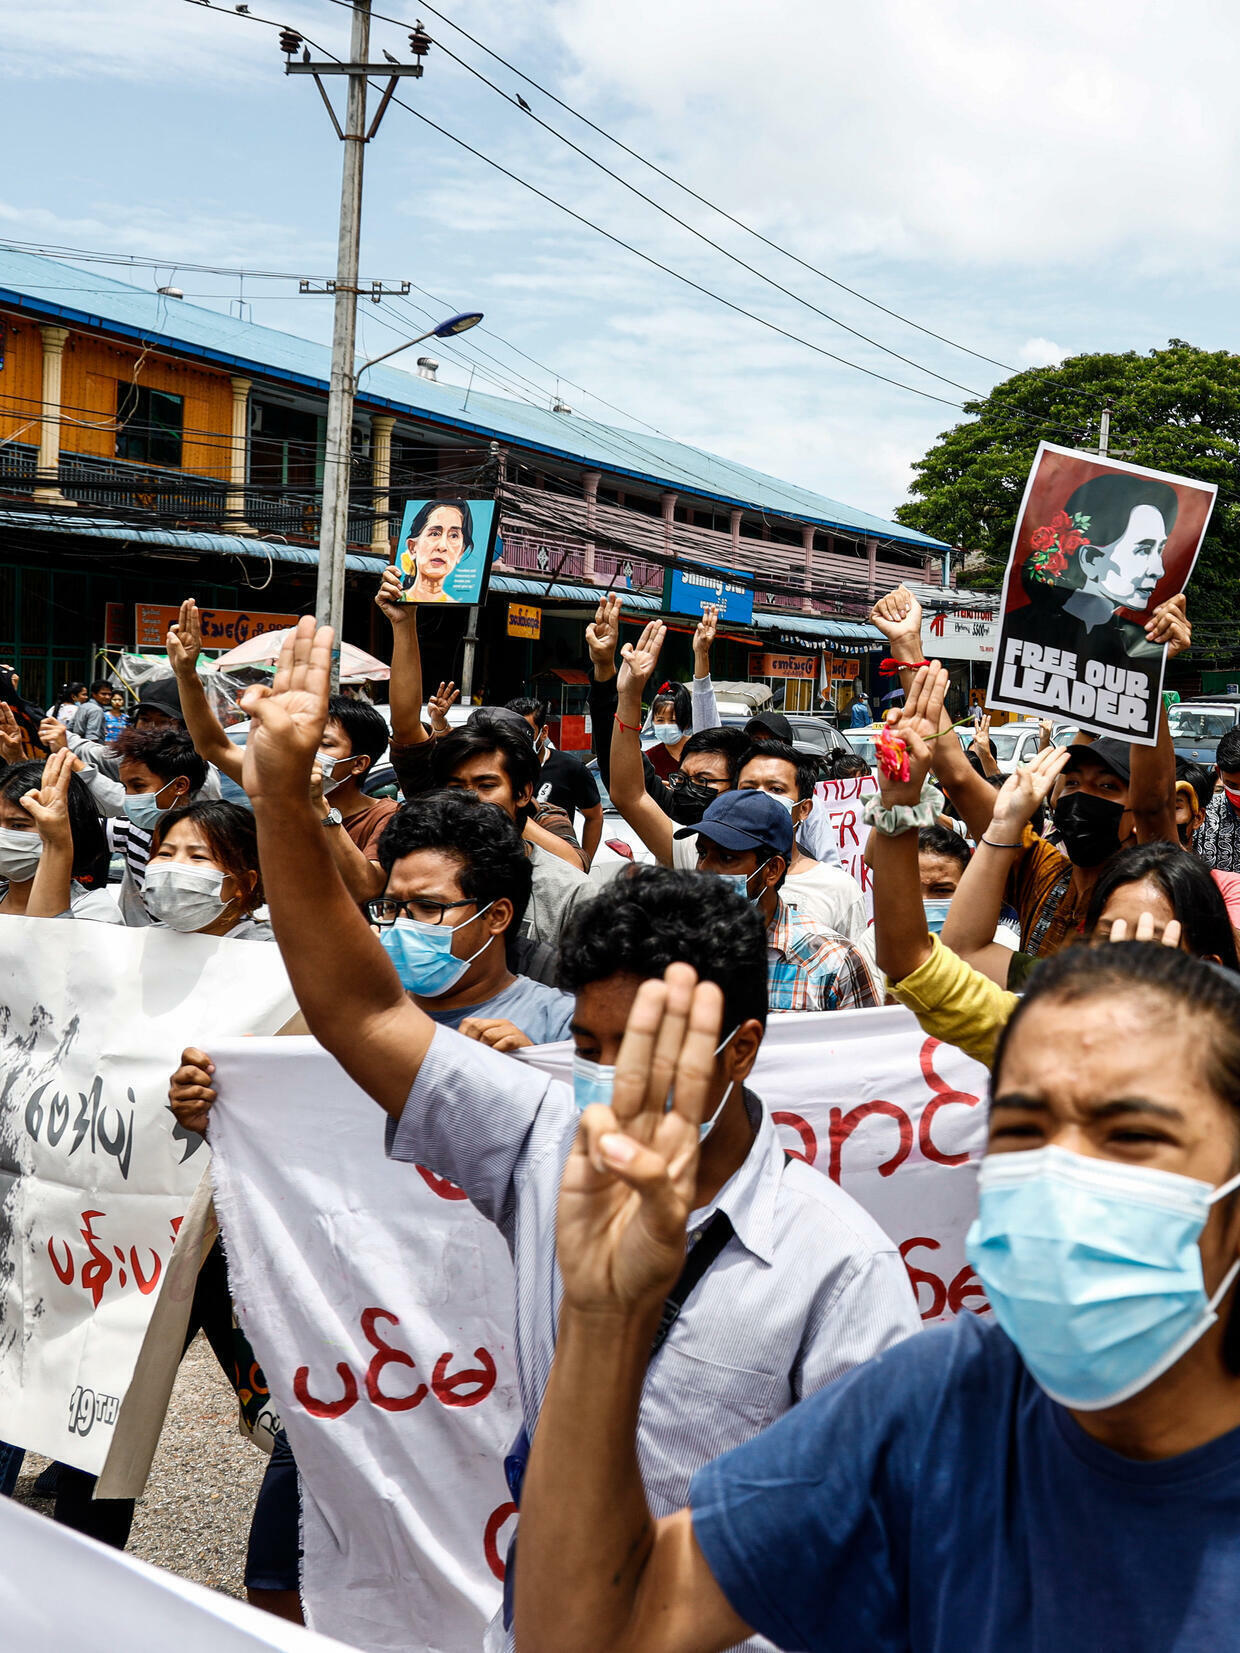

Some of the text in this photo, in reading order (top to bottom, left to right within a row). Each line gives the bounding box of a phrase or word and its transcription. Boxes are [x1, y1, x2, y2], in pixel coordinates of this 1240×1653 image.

[999, 663, 1149, 733] LEADER
[1004, 637, 1150, 699] FREE OUR
[68, 1385, 120, 1437] 19TH
